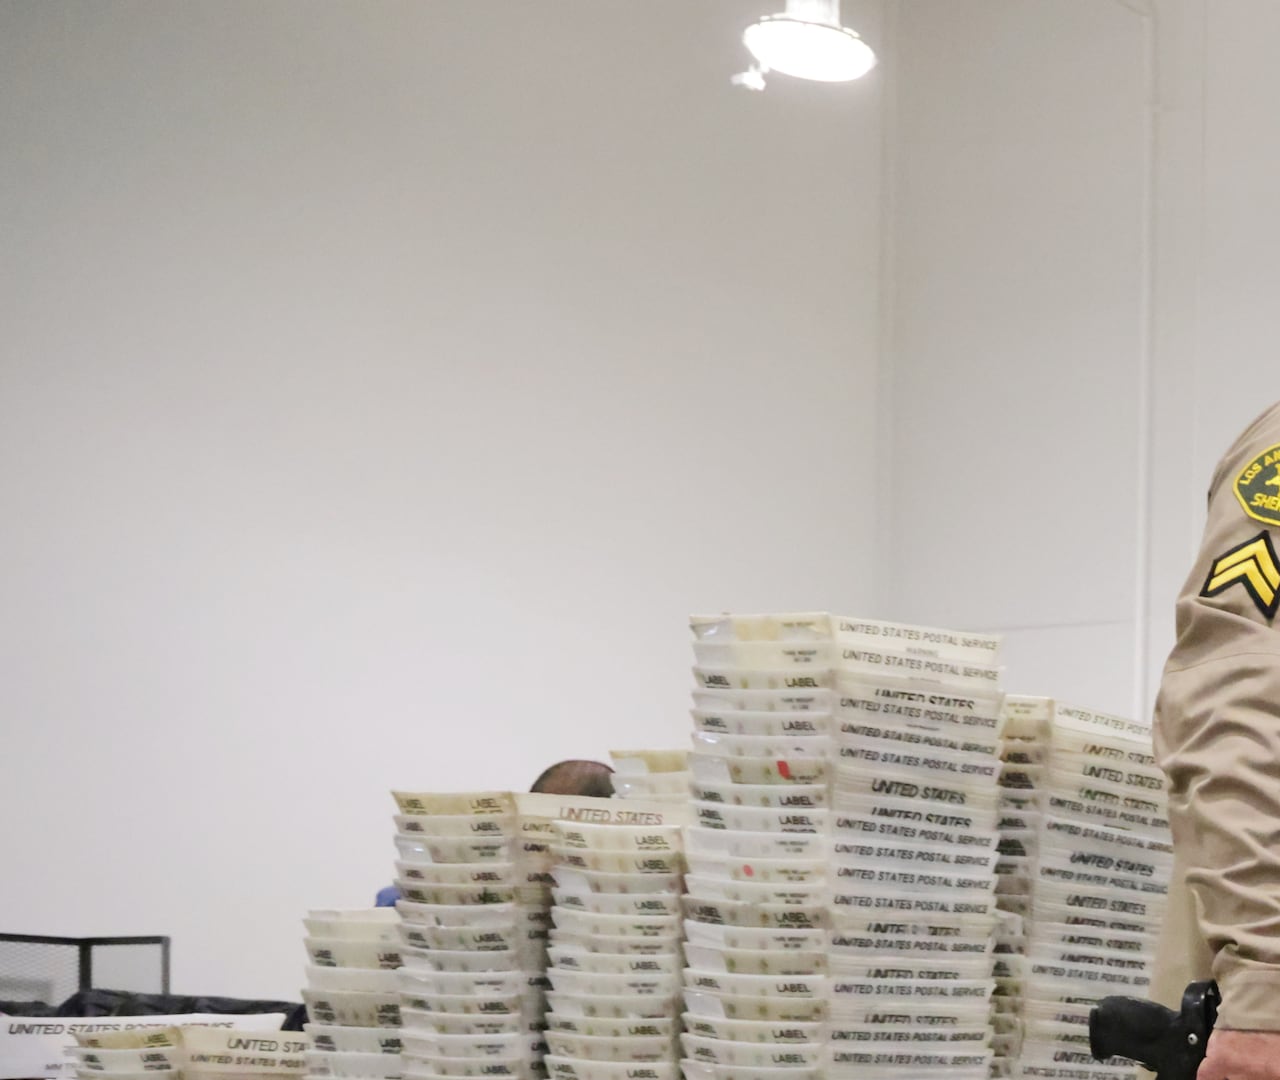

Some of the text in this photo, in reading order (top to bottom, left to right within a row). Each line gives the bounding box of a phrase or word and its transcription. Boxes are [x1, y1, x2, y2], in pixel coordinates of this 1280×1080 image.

[1240, 463, 1262, 485] LOS
[843, 649, 998, 680] UNITED STATES POSTAL SERVICE
[784, 677, 819, 687] LABEL
[840, 698, 997, 728] UNITED STATES POSTAL SERVICE
[1058, 707, 1091, 721] UNITED
[1092, 715, 1125, 730] STATES
[781, 721, 816, 731] LABEL
[840, 748, 994, 776] UNITED STATES POSTAL SERVICE
[1082, 765, 1164, 790] UNITED STATES
[872, 778, 966, 804] UNITED STATES
[779, 795, 815, 806] LABEL
[560, 807, 663, 825] UNITED STATES
[778, 816, 813, 826] LABEL
[837, 818, 992, 847] UNITED STATES POSTAL SERVICE
[634, 835, 669, 846] LABEL
[635, 860, 671, 870] LABEL
[838, 868, 991, 890] UNITED STATES POSTAL SERVICE
[633, 901, 667, 910] LABEL
[629, 962, 661, 970] LABEL
[776, 984, 811, 993] LABEL
[8, 1023, 65, 1034] UNITED
[227, 1038, 279, 1052] UNITED
[190, 1054, 234, 1063] UNITED
[236, 1056, 277, 1067] STATES
[772, 1054, 807, 1063] LABEL
[627, 1070, 659, 1078] LABEL
